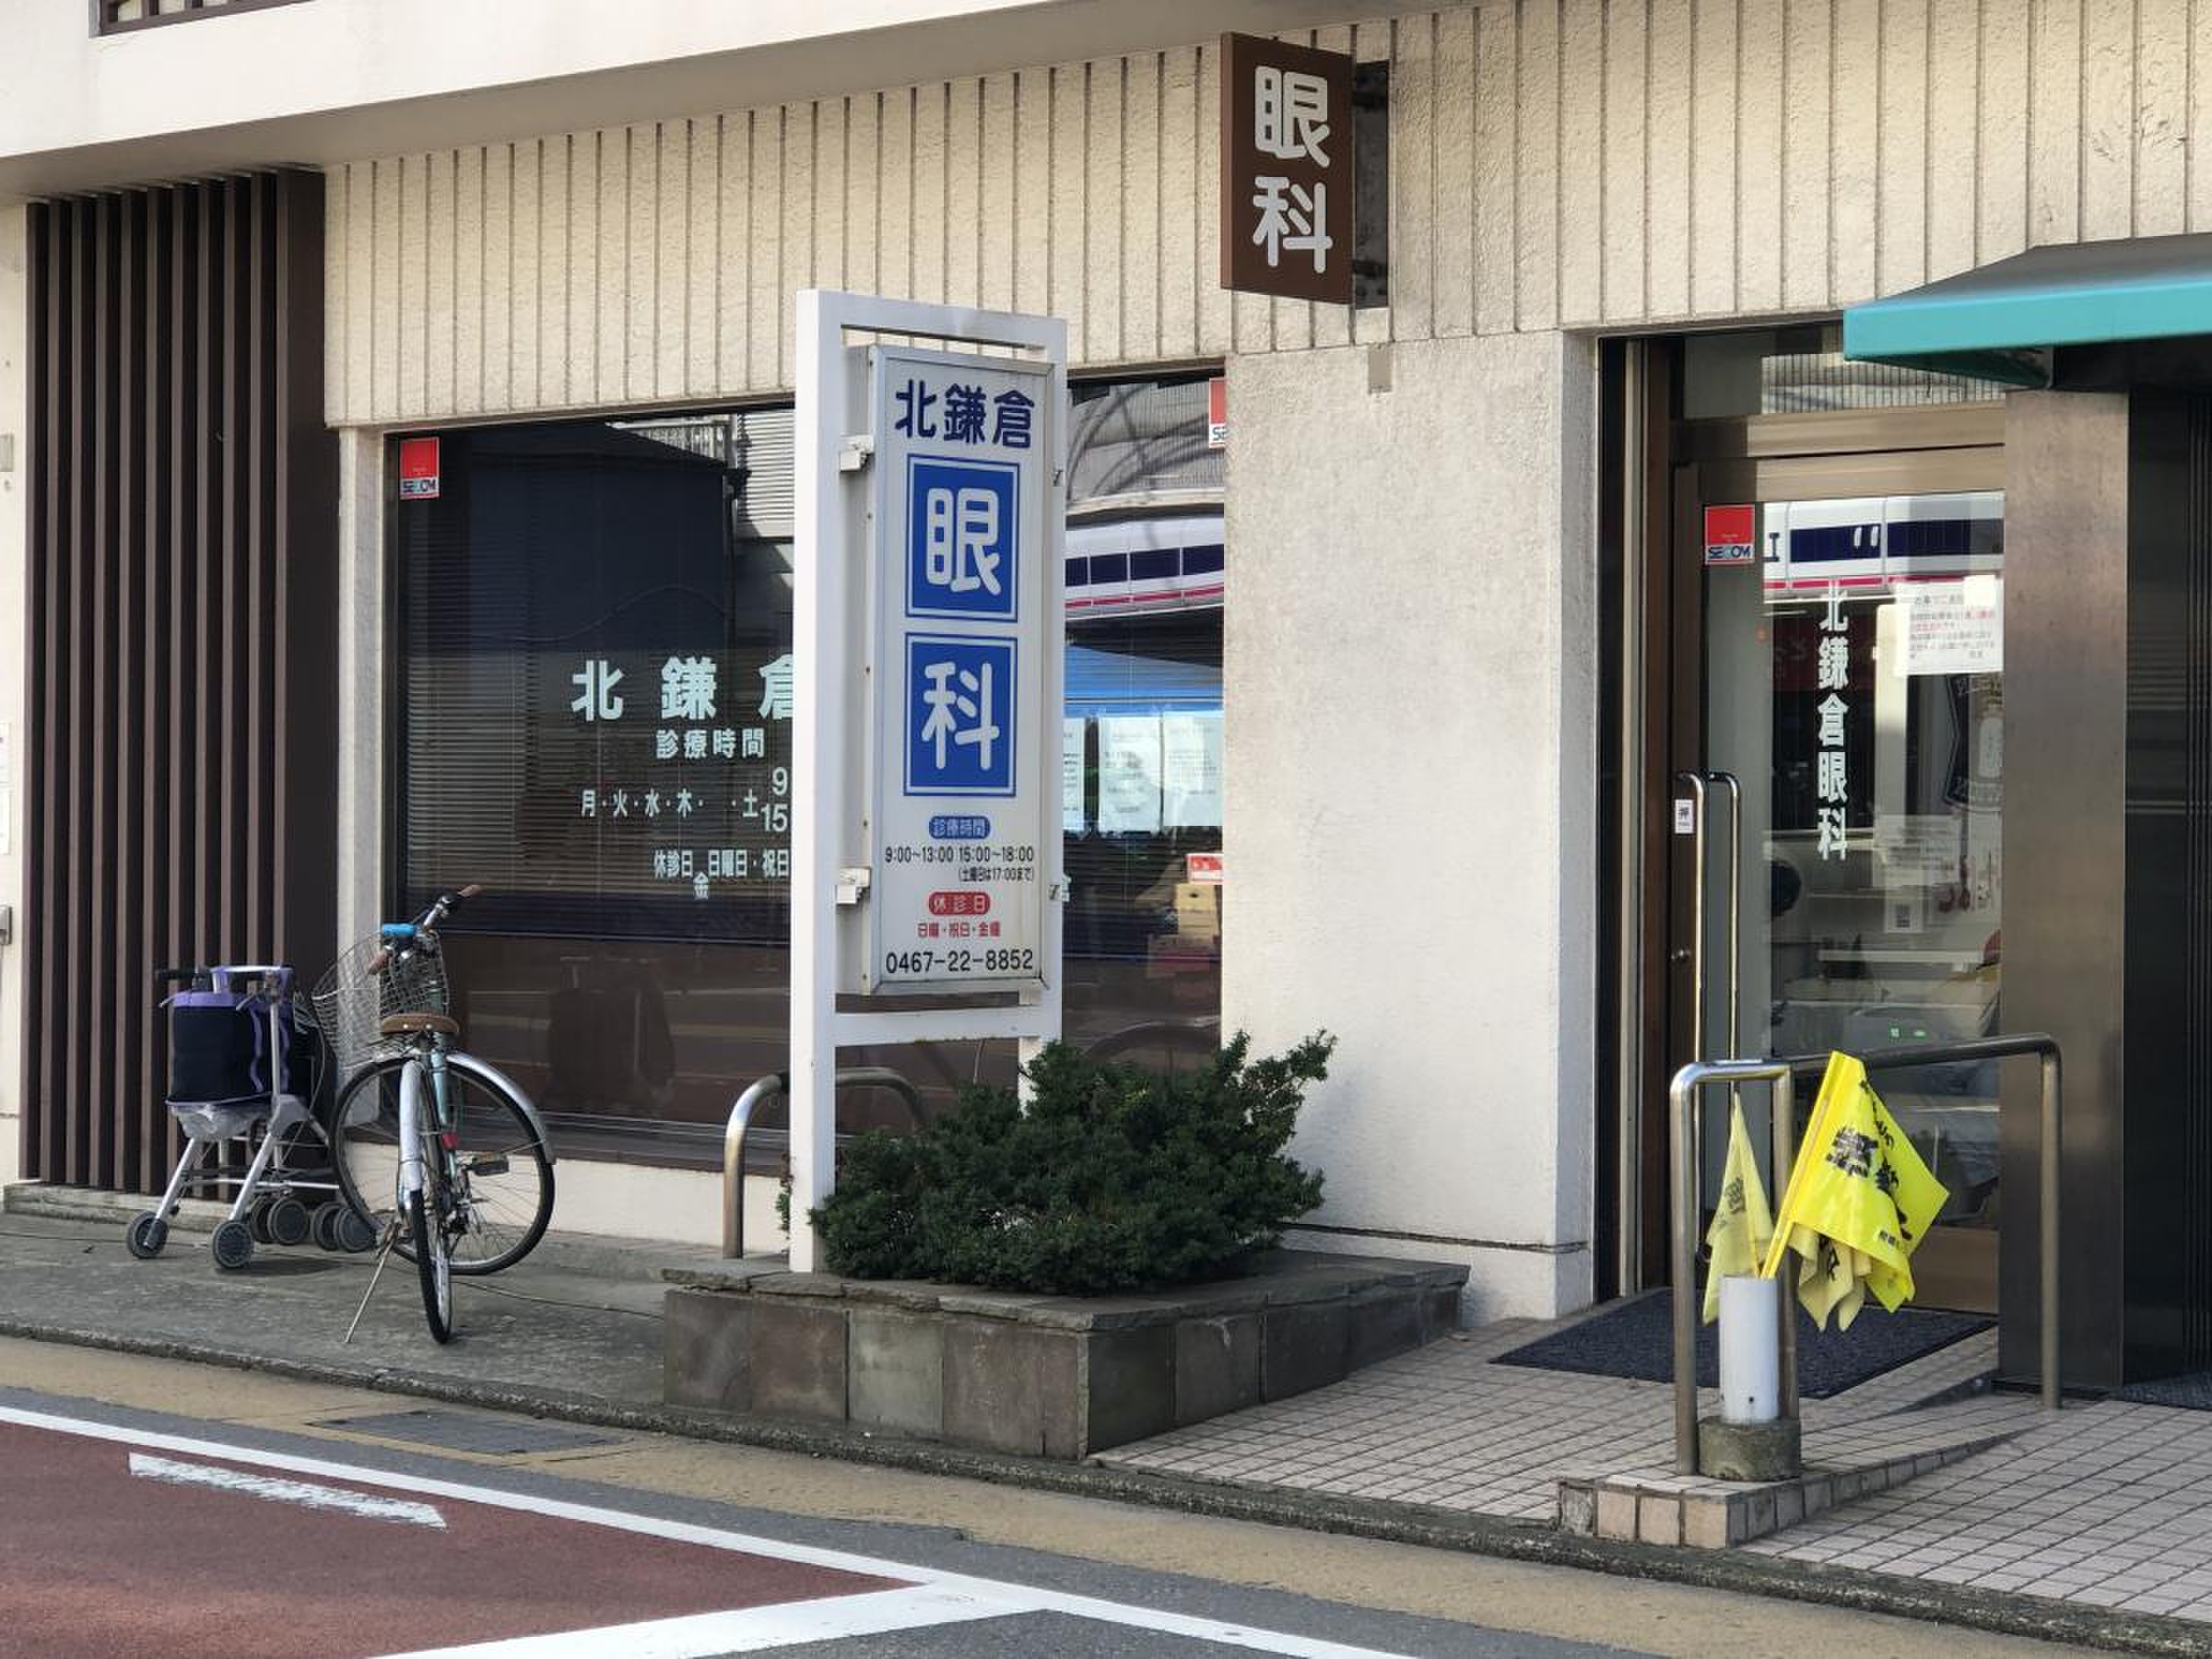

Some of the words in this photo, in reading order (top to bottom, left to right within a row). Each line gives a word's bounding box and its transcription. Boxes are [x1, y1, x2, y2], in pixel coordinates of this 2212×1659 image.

[1253, 65, 1333, 274] 眼科
[895, 379, 1035, 450] 北鎌倉
[1818, 580, 1849, 861] 北鎌倉眼科
[655, 727, 765, 759] 診療時間
[760, 803, 788, 832] 15
[932, 818, 986, 838] 診療時間
[653, 848, 693, 878] 休診日
[693, 871, 709, 900] 金
[933, 896, 986, 912] 休診日
[886, 948, 1033, 974] 0467-22-8852
